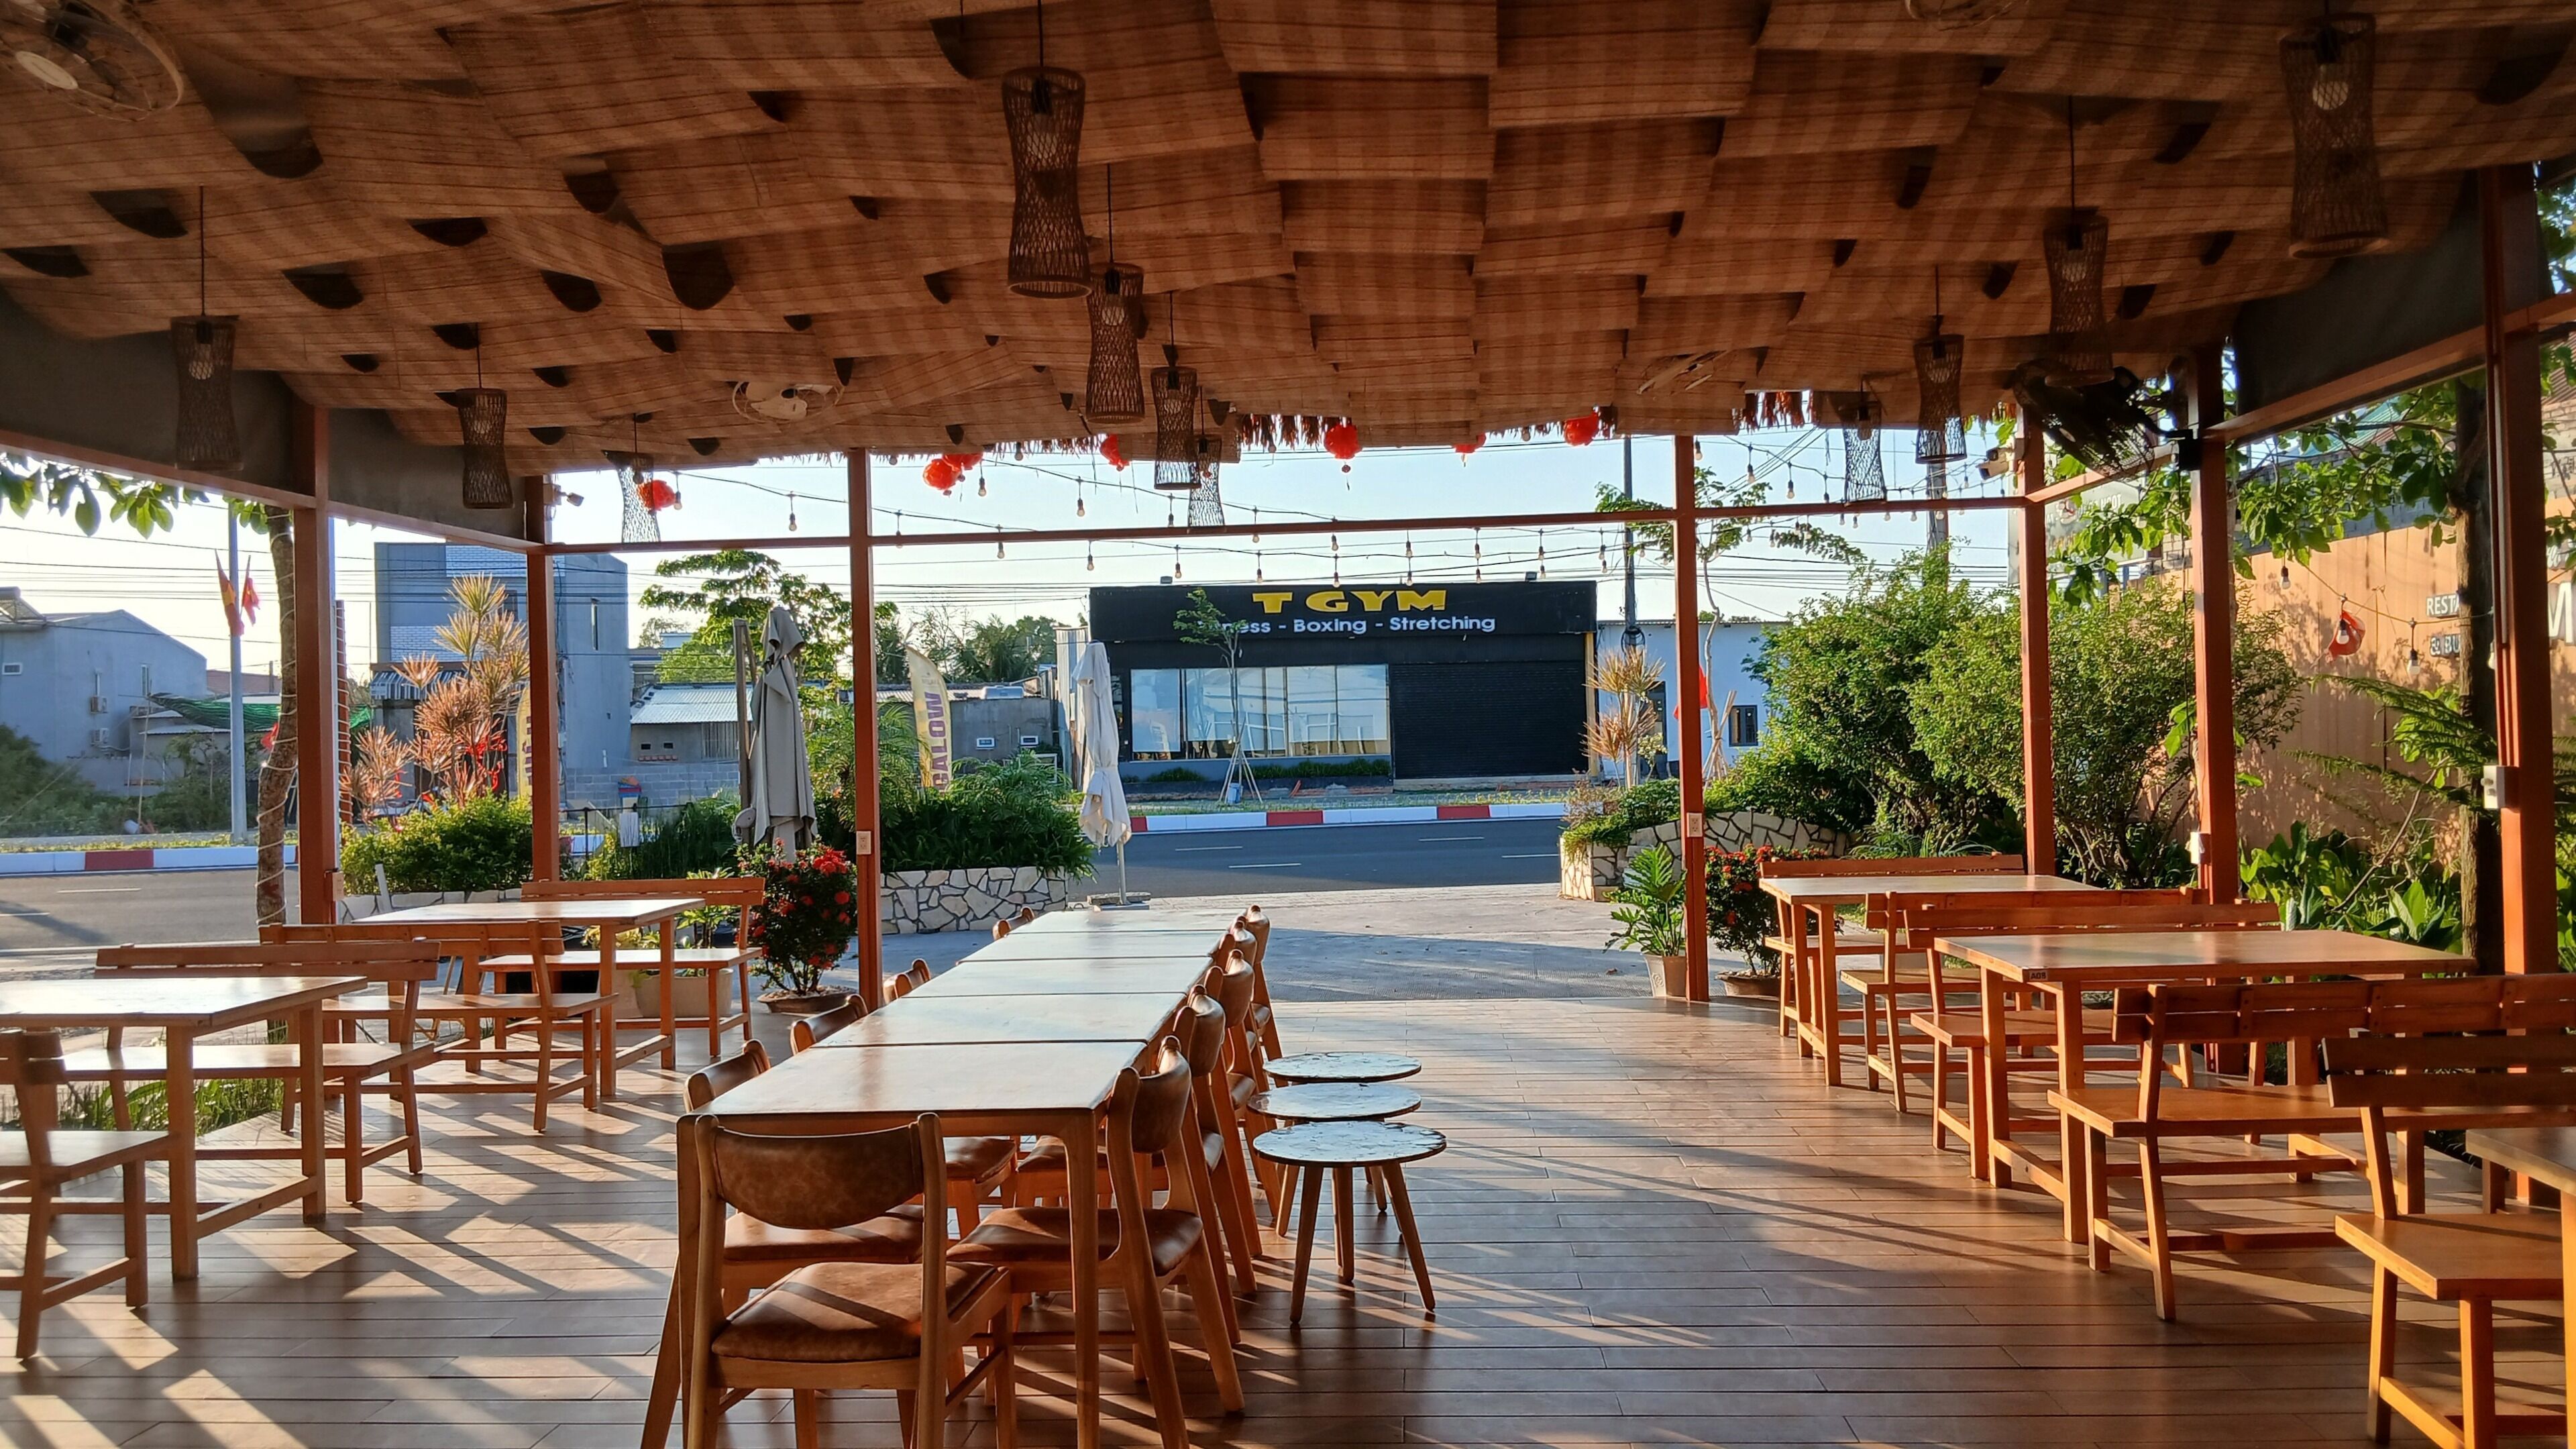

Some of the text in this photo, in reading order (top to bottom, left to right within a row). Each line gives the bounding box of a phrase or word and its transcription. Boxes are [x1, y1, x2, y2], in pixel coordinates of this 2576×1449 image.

[1252, 589, 1447, 614] T GYM
[1293, 619, 1367, 635] Boxing
[1389, 616, 1496, 633] Stretching
